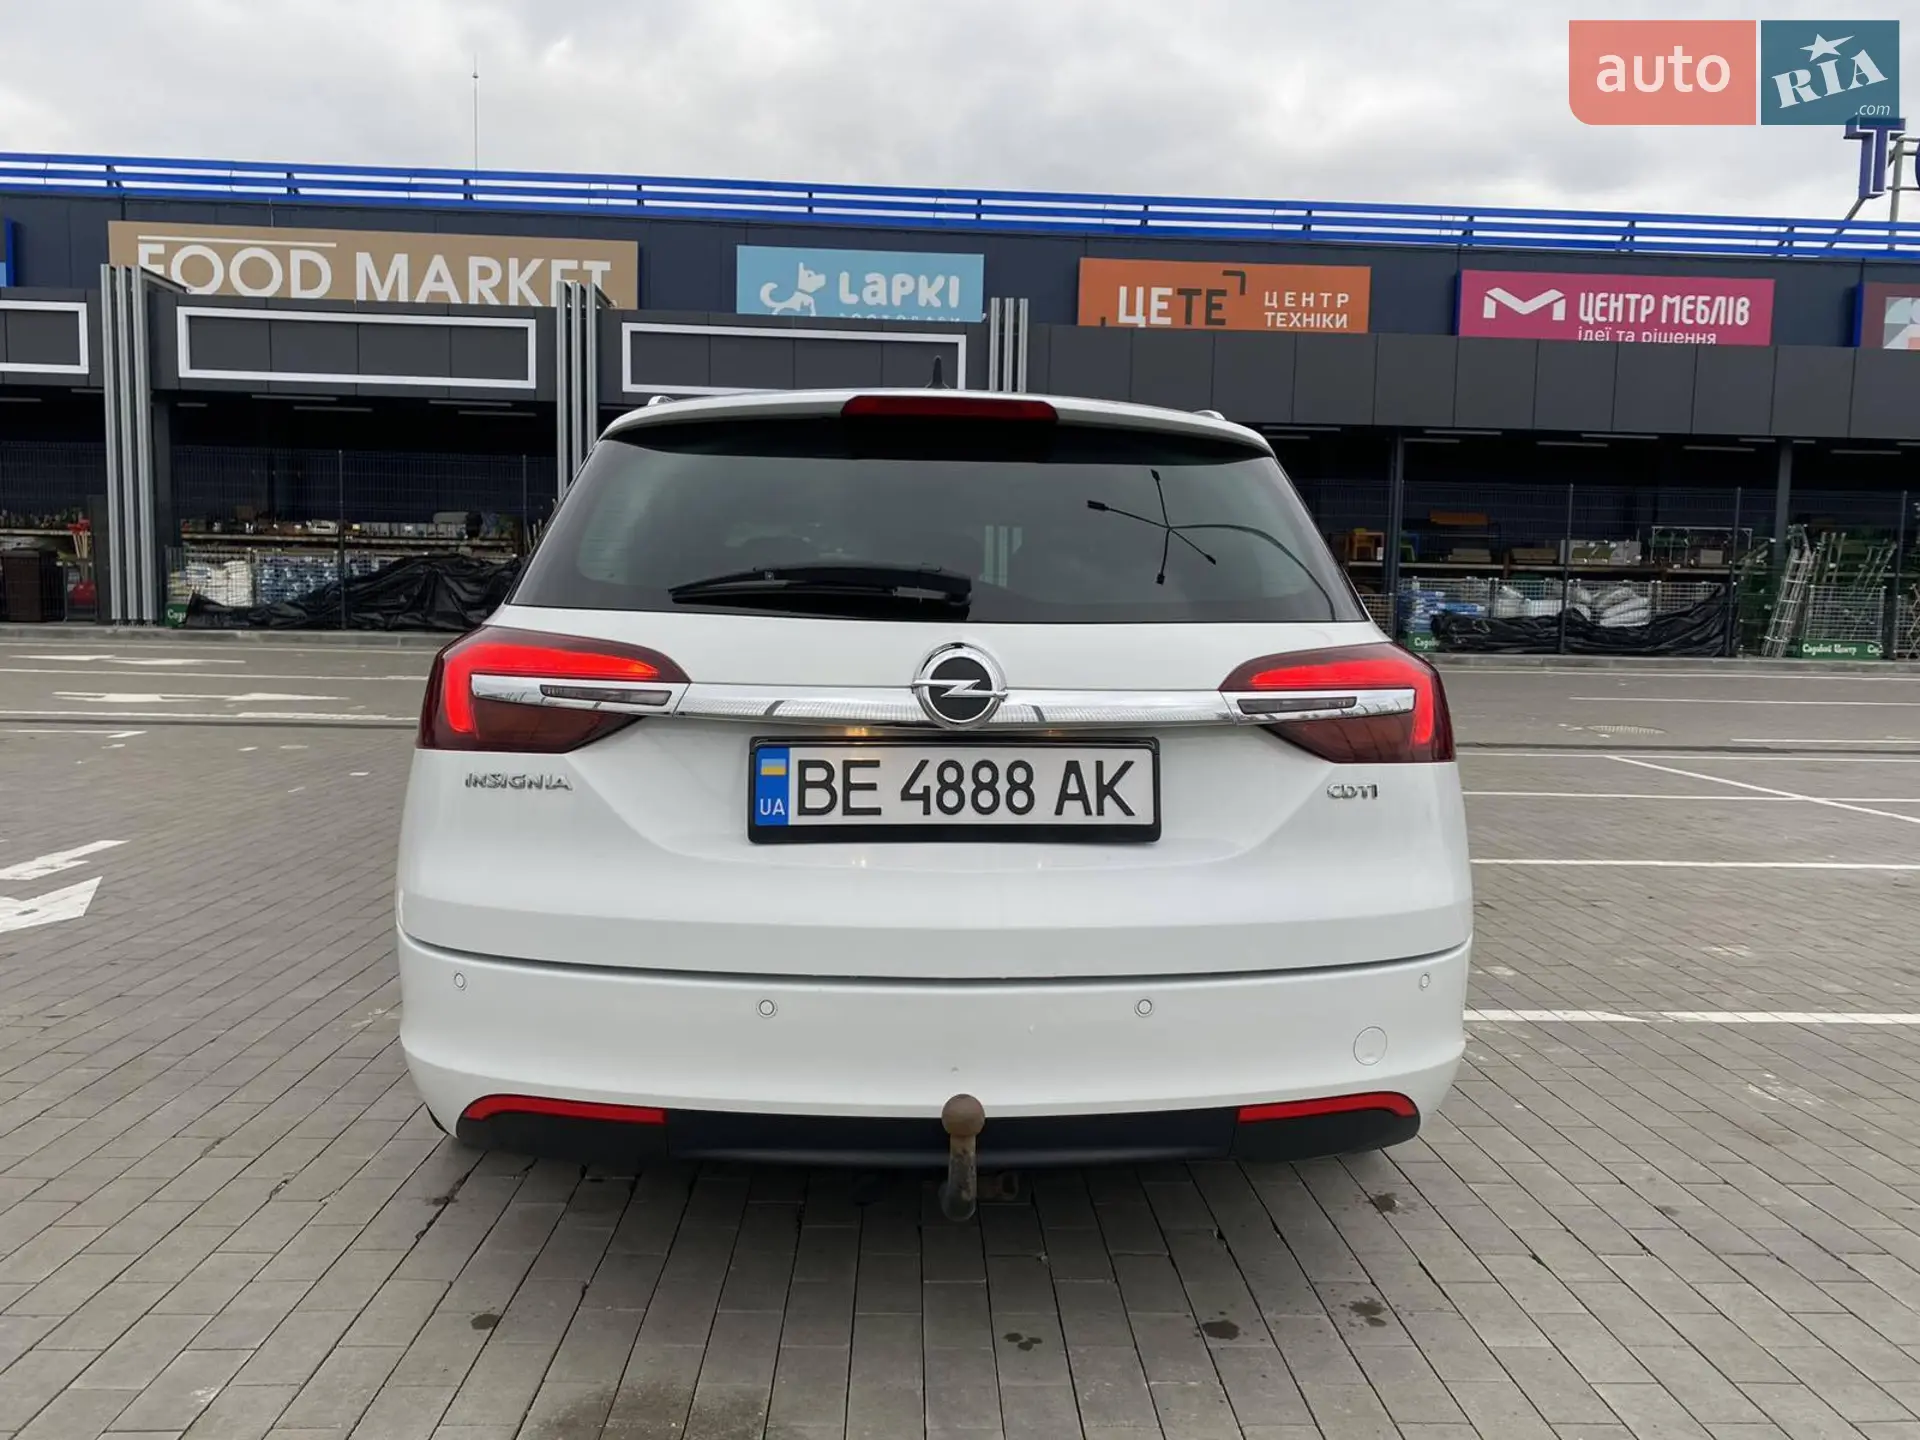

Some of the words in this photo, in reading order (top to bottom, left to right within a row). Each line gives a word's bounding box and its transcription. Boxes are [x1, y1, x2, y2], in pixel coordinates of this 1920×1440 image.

[1117, 285, 1227, 328] ЦЕТЕ
[1264, 291, 1350, 309] ЦЕНТР
[1578, 292, 1656, 324] ЦЕНТР
[1661, 294, 1750, 326] МЕБЛІВ
[1264, 311, 1348, 329] ТЕХНІКИ
[1616, 329, 1635, 343] та
[465, 773, 572, 791] INSIGNIA
[796, 759, 882, 816] BE
[900, 759, 1036, 816] 4888
[1053, 760, 1136, 816] AK
[760, 798, 786, 816] UA
